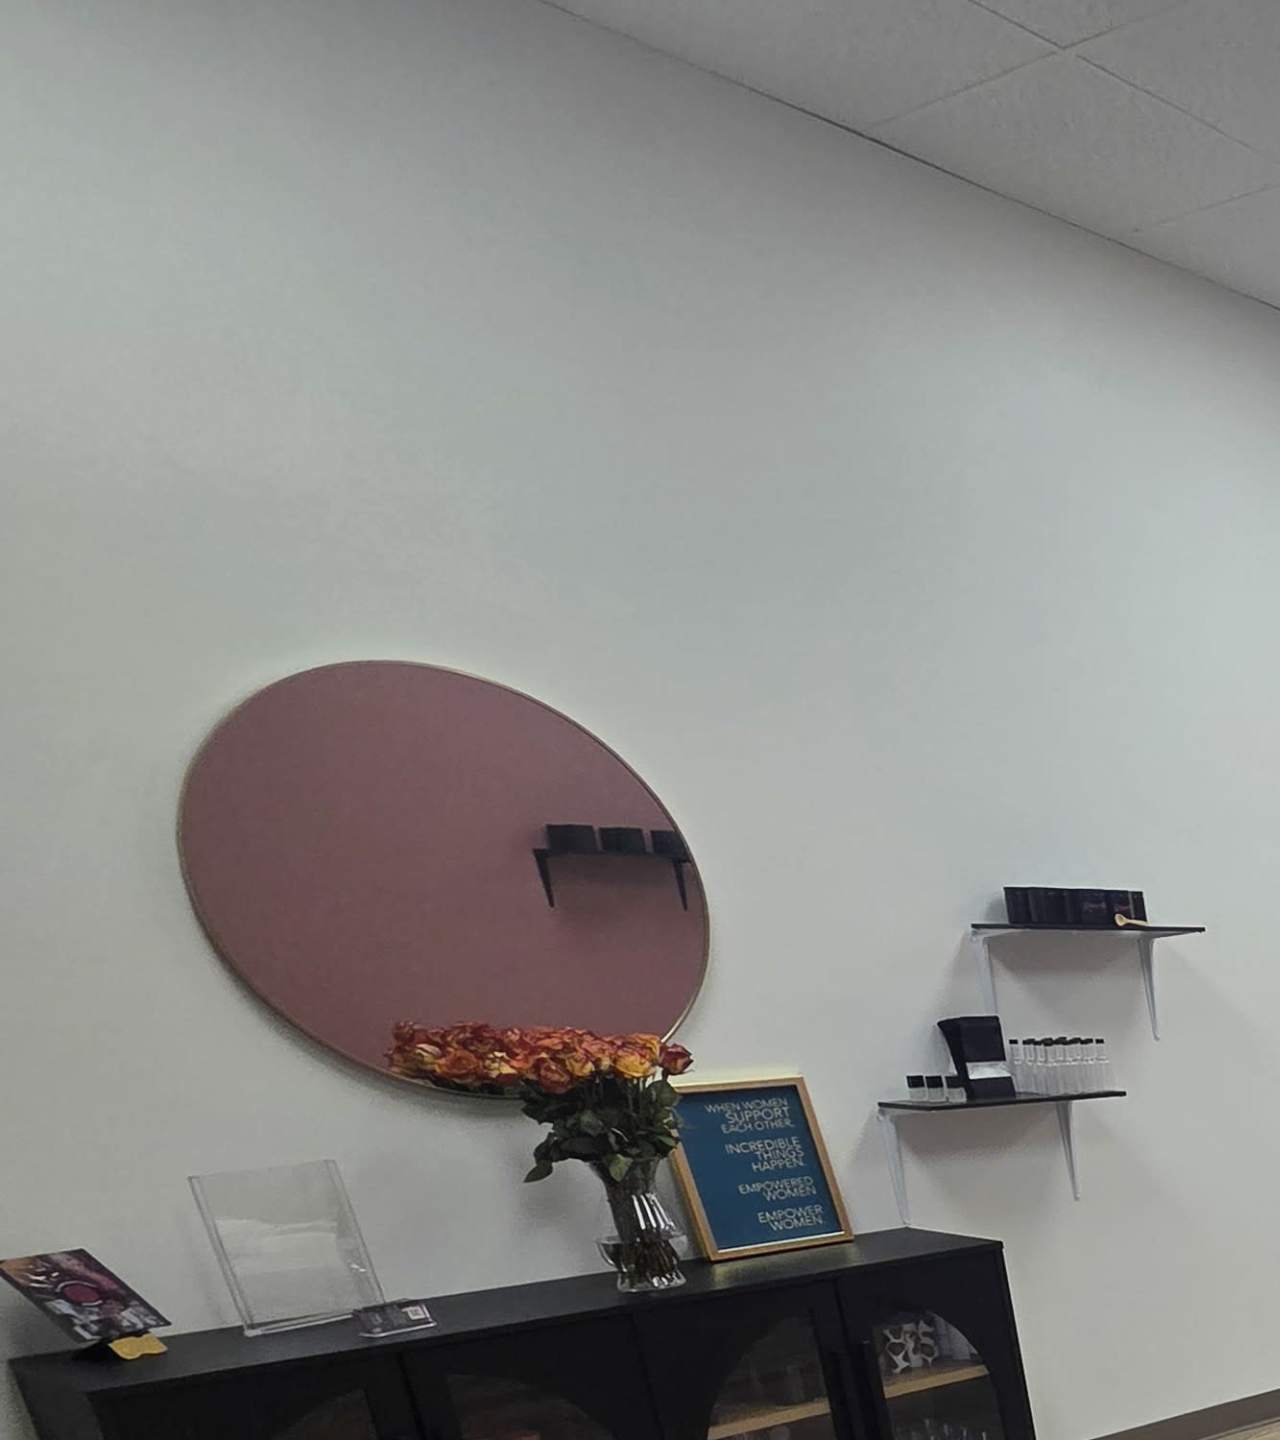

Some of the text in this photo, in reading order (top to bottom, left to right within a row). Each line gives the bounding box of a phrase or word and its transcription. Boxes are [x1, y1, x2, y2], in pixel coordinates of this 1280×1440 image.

[705, 1098, 788, 1113] WHEN WOMEN
[725, 1107, 789, 1124] SUPPORT
[721, 1122, 753, 1134] EACH
[725, 1137, 801, 1154] INCREDIBLE
[755, 1147, 804, 1160] THINGS
[738, 1176, 814, 1195] EMPOWERED
[763, 1185, 817, 1201] WOMEN
[757, 1204, 823, 1224] EMPOWER
